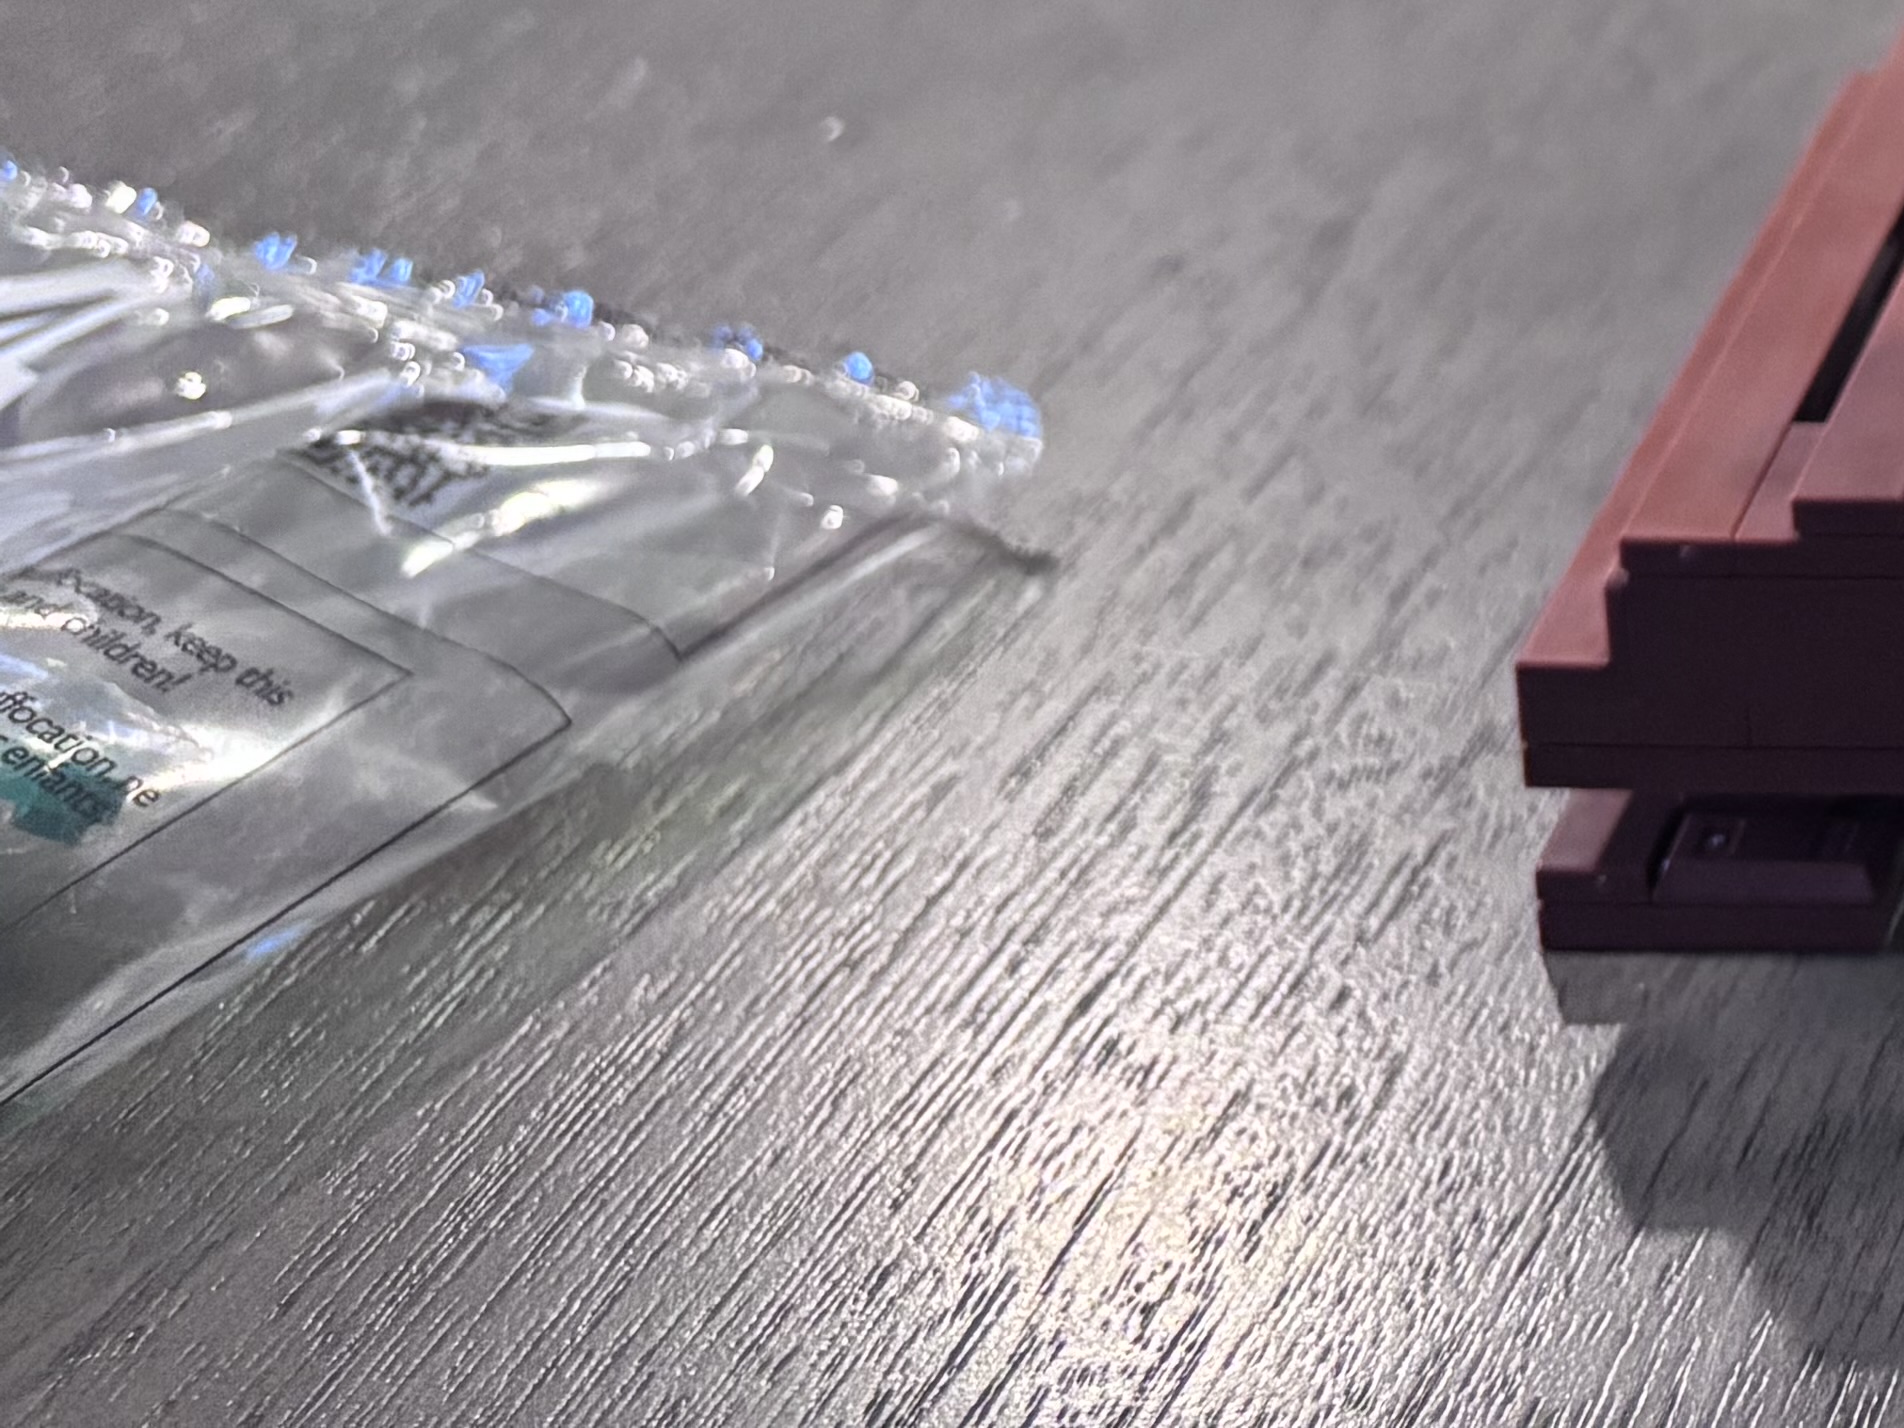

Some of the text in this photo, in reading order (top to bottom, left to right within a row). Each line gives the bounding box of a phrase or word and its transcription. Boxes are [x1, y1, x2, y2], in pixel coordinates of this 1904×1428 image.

[60, 614, 193, 693] children!
[165, 622, 238, 676] keep
[234, 664, 294, 707] this
